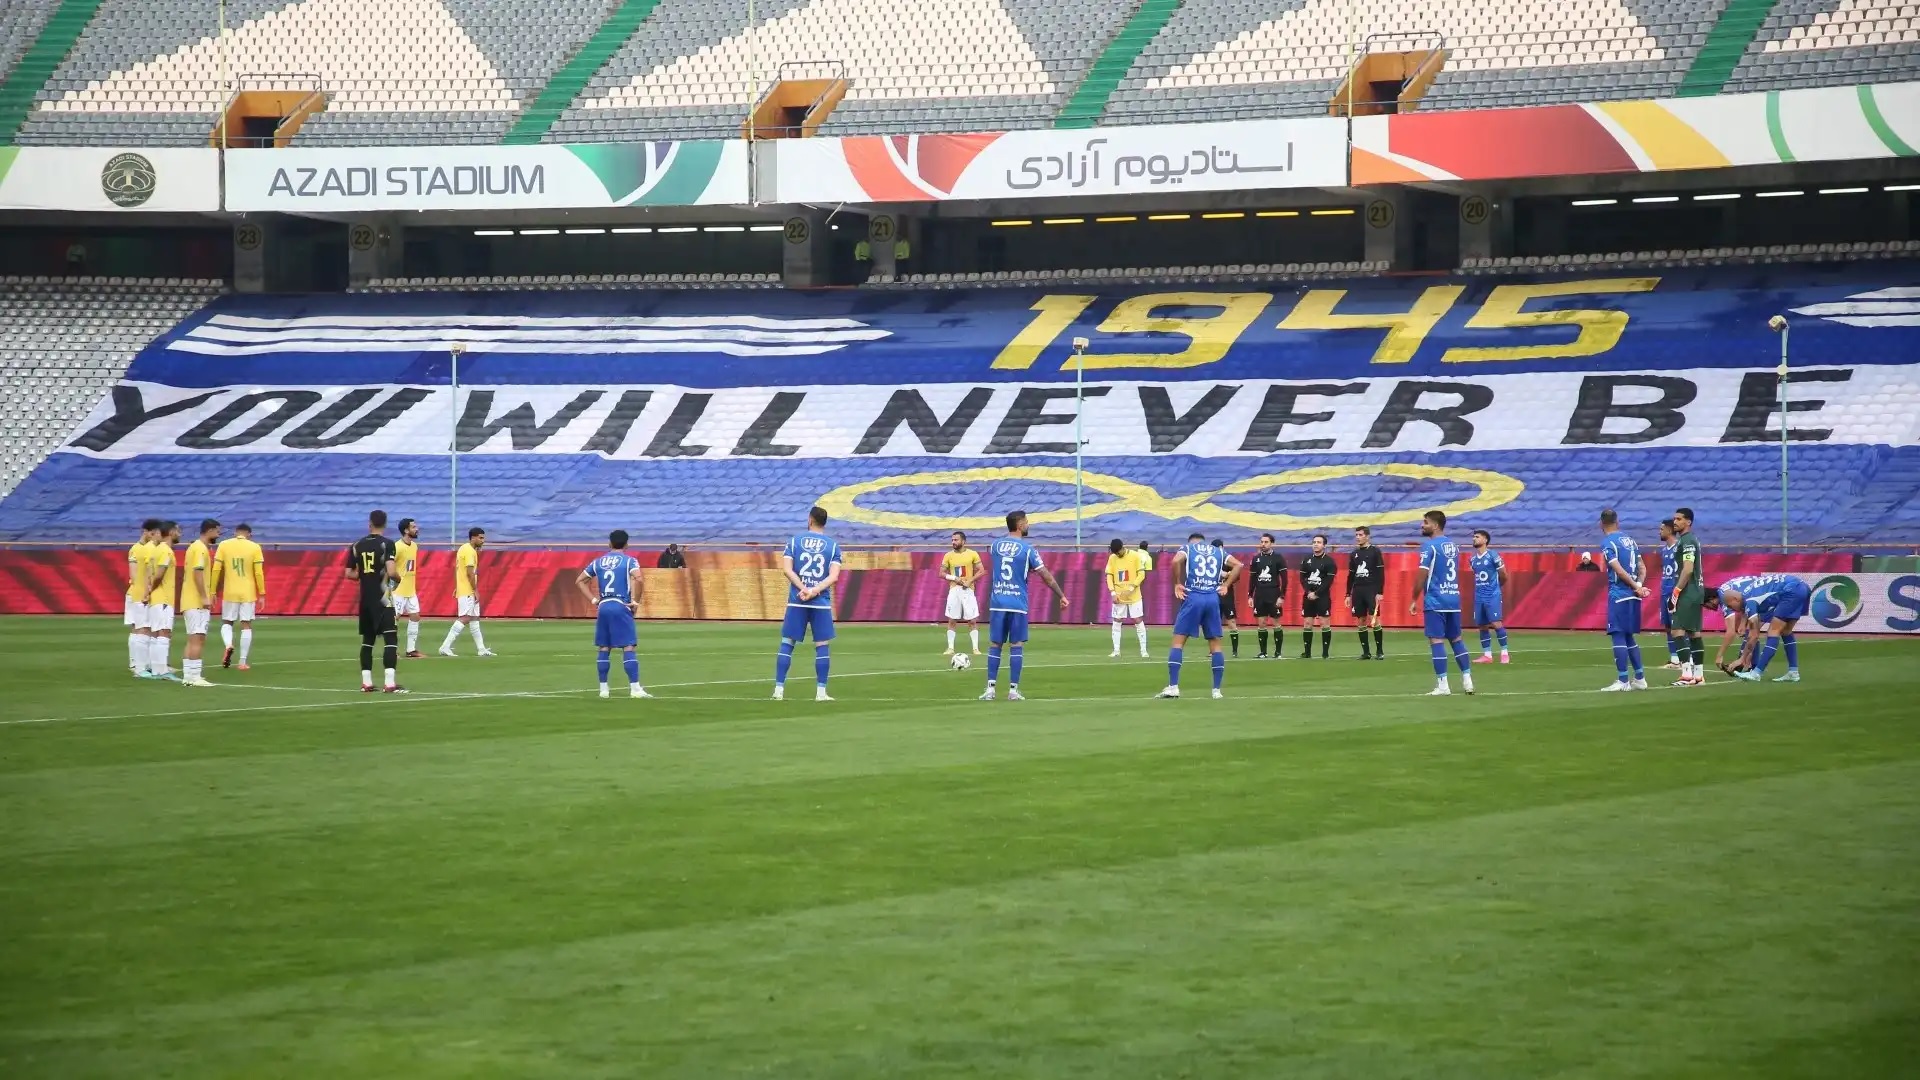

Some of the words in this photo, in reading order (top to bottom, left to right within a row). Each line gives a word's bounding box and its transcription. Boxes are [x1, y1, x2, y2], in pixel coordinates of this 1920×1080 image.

[1006, 138, 1108, 190] آزادی
[1114, 142, 1293, 186] استادیوم
[267, 167, 378, 197] AZADI
[386, 164, 545, 196] STADIUM
[1370, 206, 1387, 222] 21
[1466, 202, 1484, 218] 20
[239, 229, 257, 245] 23
[354, 229, 372, 246] 22
[788, 224, 806, 239] 22
[874, 221, 889, 237] 21
[990, 276, 1662, 371] 1945
[70, 383, 437, 452] YOU
[449, 387, 810, 458] WILL
[852, 379, 1494, 455] NEVER
[1561, 368, 1854, 446] BE
[231, 557, 245, 578] 41
[799, 552, 826, 578] 23
[1000, 556, 1014, 581] 5
[1194, 554, 1218, 578] 33
[1446, 558, 1457, 582] 3
[1629, 550, 1637, 573] 4
[603, 570, 616, 593] 2
[1886, 575, 1920, 631] S
